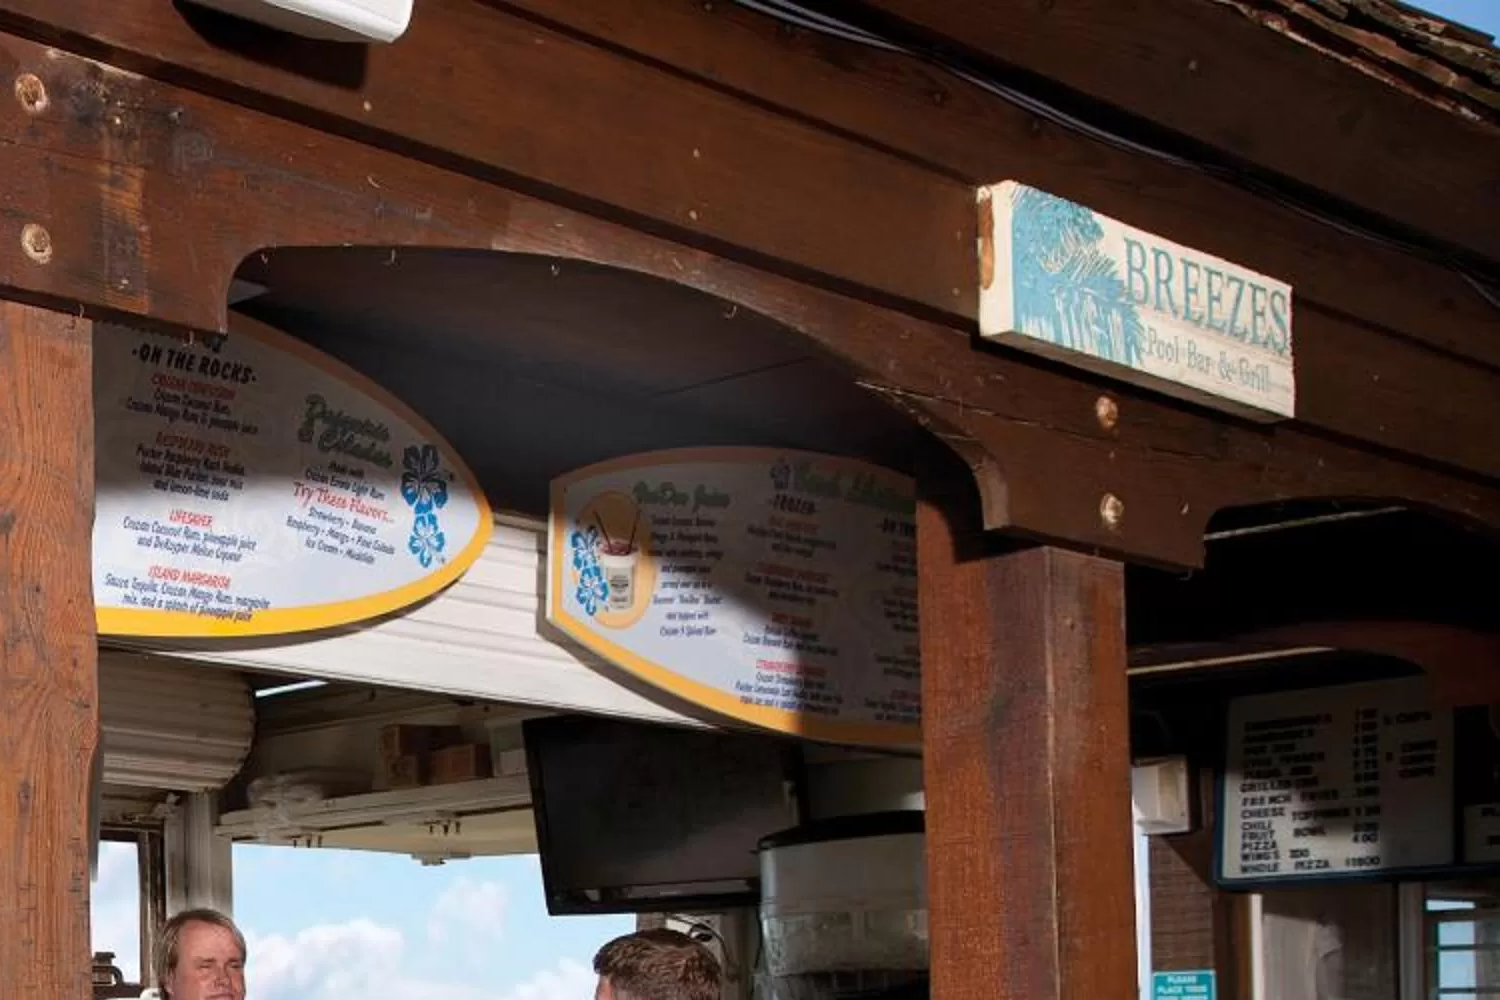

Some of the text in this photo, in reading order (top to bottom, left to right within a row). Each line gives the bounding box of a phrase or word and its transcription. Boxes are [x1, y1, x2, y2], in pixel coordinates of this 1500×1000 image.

[1124, 237, 1289, 352] BREEZES
[166, 350, 197, 373] THE
[1148, 328, 1269, 393] Pool Bar & Grill
[153, 479, 168, 491] and
[370, 485, 385, 501] Rum
[293, 482, 314, 506] Try
[316, 487, 348, 508] These
[123, 515, 150, 533] Cruzan
[152, 521, 182, 537] Coconut
[137, 536, 152, 549] and
[305, 537, 317, 550] Ice
[318, 539, 339, 555] Cream
[148, 564, 180, 582] ISLAND
[161, 581, 187, 597] Cruzan
[188, 585, 215, 604] Mango
[141, 594, 156, 608] and
[164, 598, 189, 614] splash
[199, 604, 235, 621] pineapple
[234, 609, 253, 624] juice
[1241, 807, 1285, 819] CHEESE
[1241, 829, 1276, 841] FRUIT
[1241, 840, 1277, 851] PIZZA
[1294, 858, 1330, 870] PIZZA
